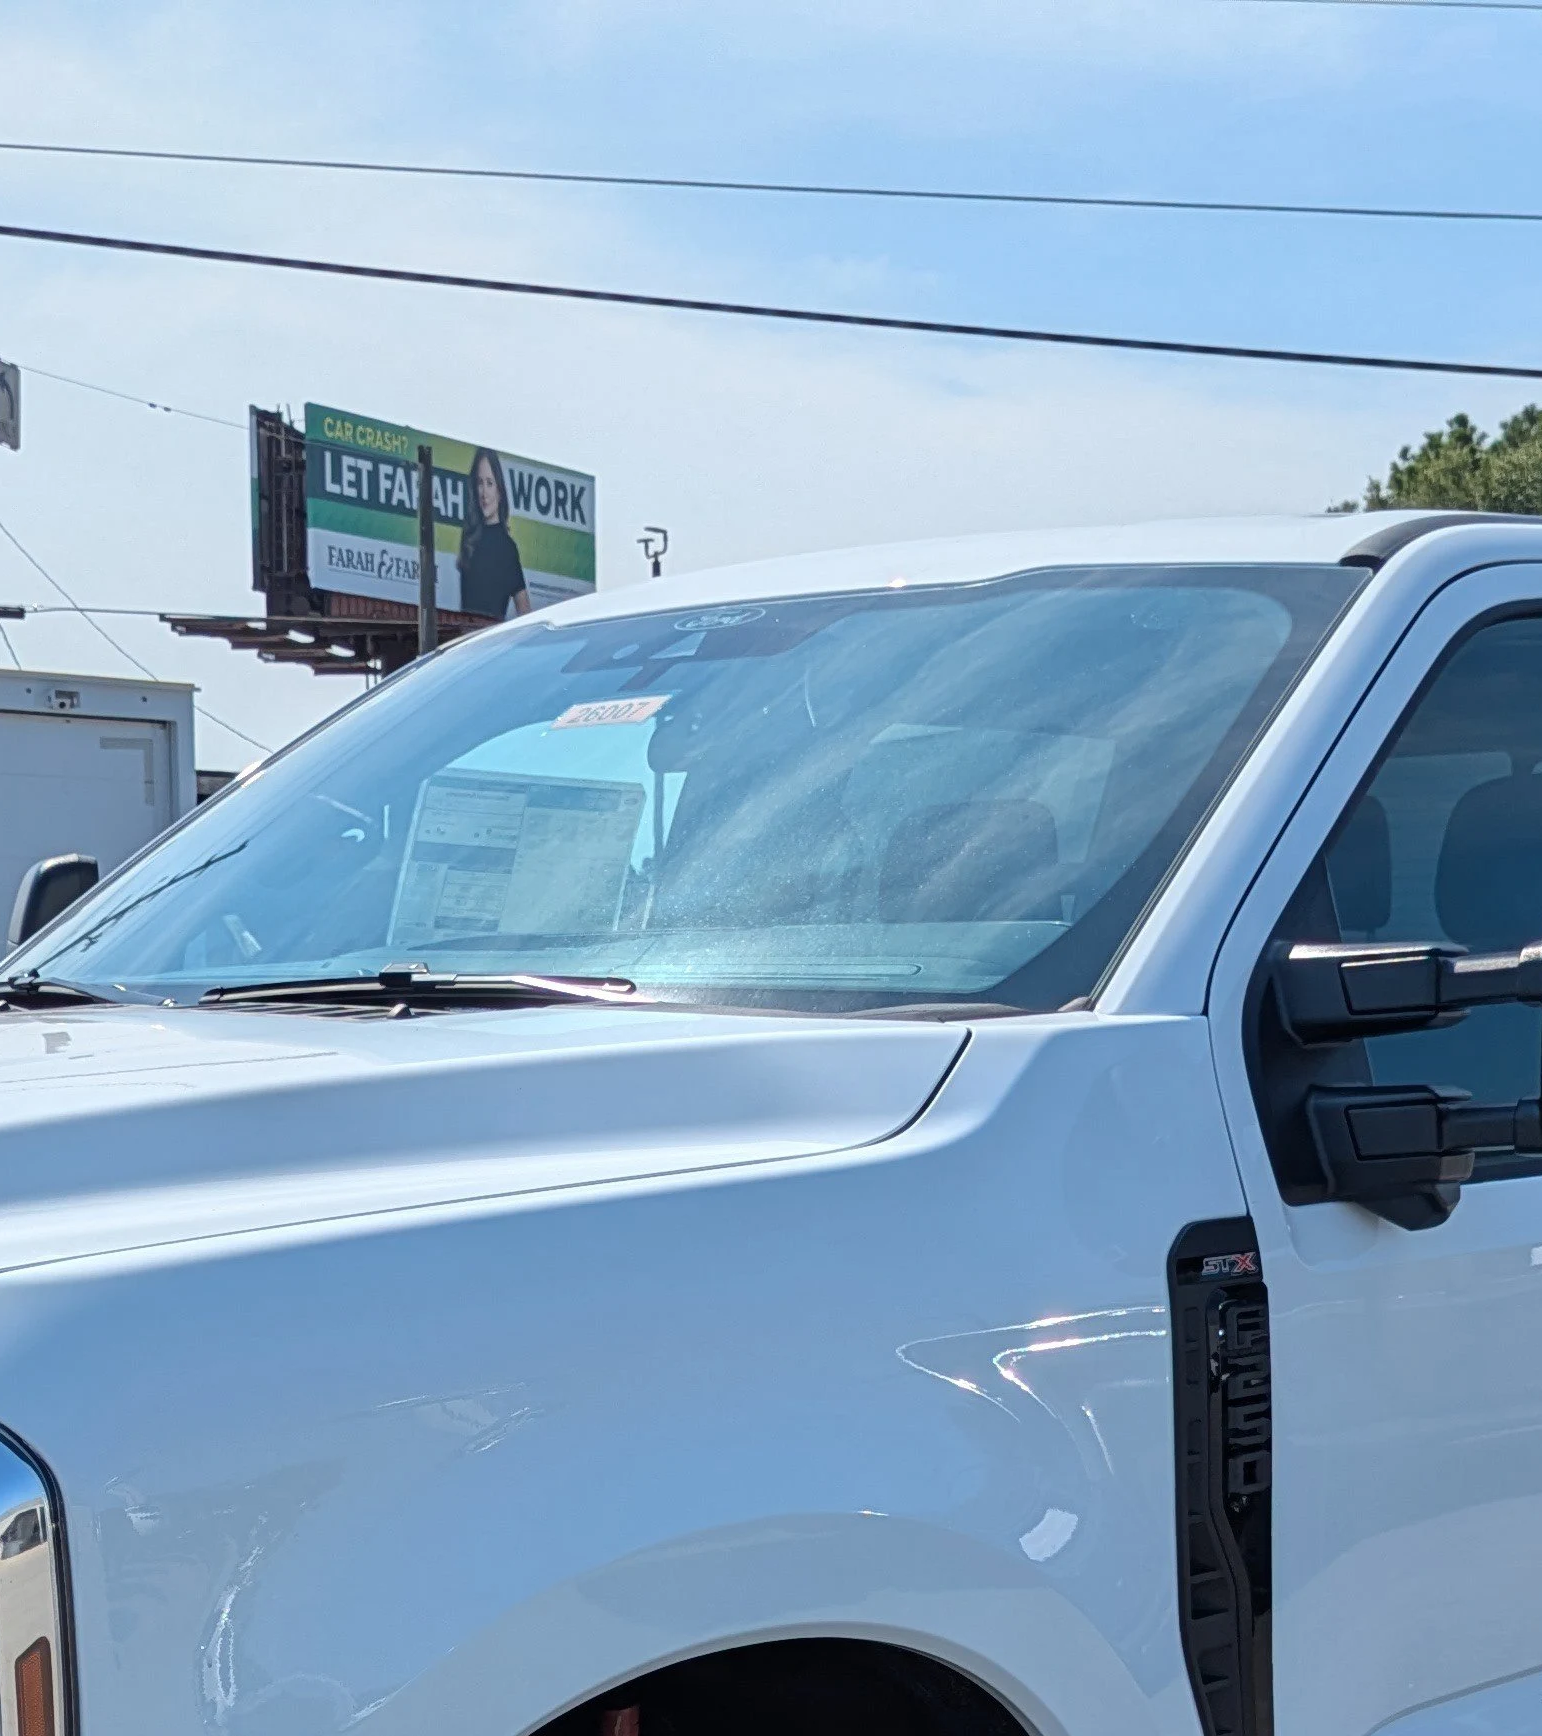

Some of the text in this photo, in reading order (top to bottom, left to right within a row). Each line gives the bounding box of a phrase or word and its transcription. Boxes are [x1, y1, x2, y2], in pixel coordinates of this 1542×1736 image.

[324, 416, 408, 456] CAR CRASH?
[324, 451, 373, 500] LET
[509, 468, 586, 525] WORK
[327, 545, 375, 573] FARAH
[1202, 1251, 1259, 1276] STX
